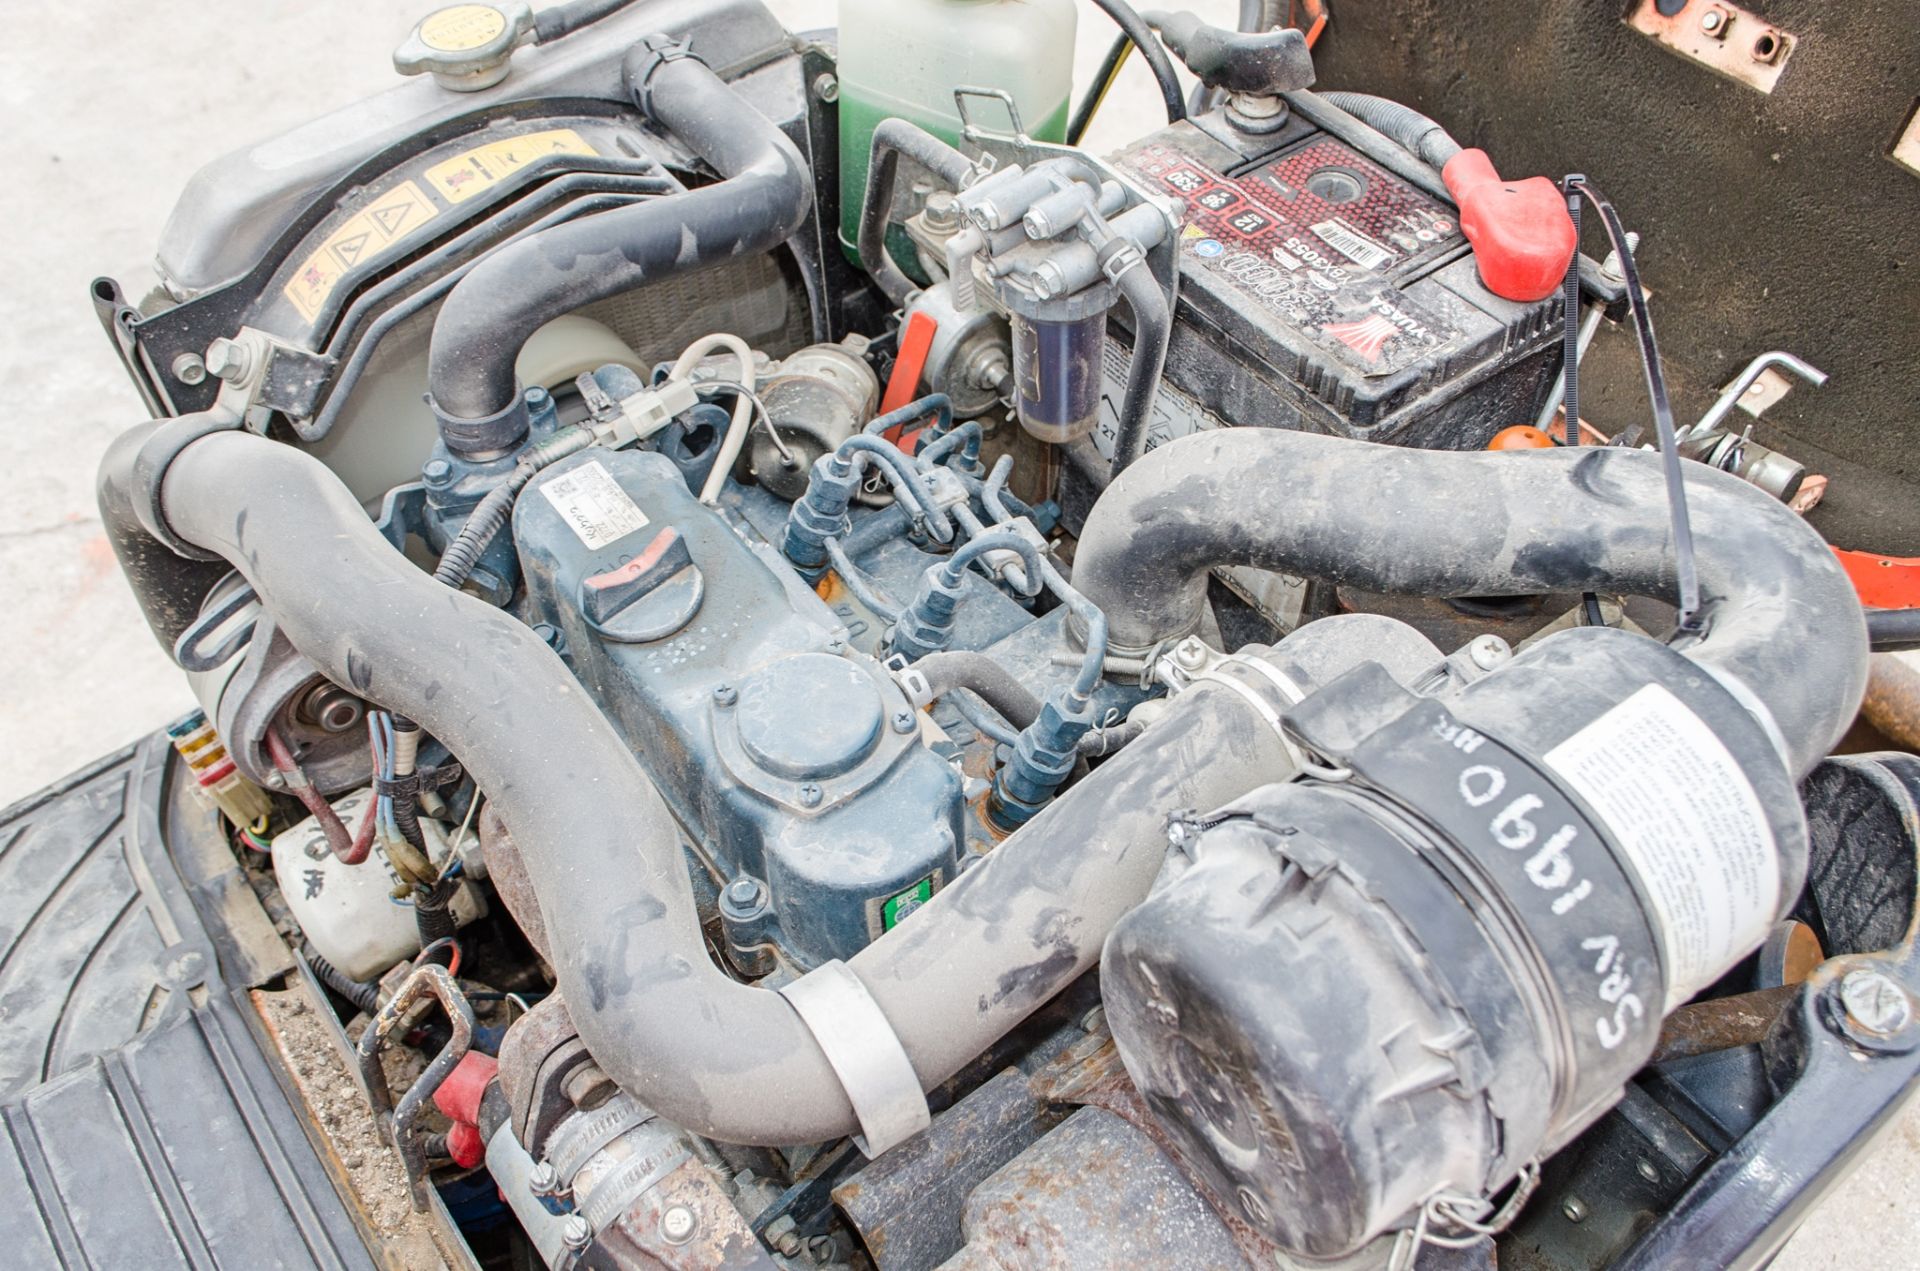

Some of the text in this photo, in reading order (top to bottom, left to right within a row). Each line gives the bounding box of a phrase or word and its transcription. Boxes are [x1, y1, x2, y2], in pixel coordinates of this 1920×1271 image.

[1166, 171, 1199, 192] 330
[1201, 194, 1227, 209] 36
[1234, 218, 1258, 232] 12
[1220, 252, 1317, 316] 3000
[1284, 237, 1352, 286] YBX3055
[1370, 295, 1427, 340] YUASA
[1458, 764, 1594, 915] 1990
